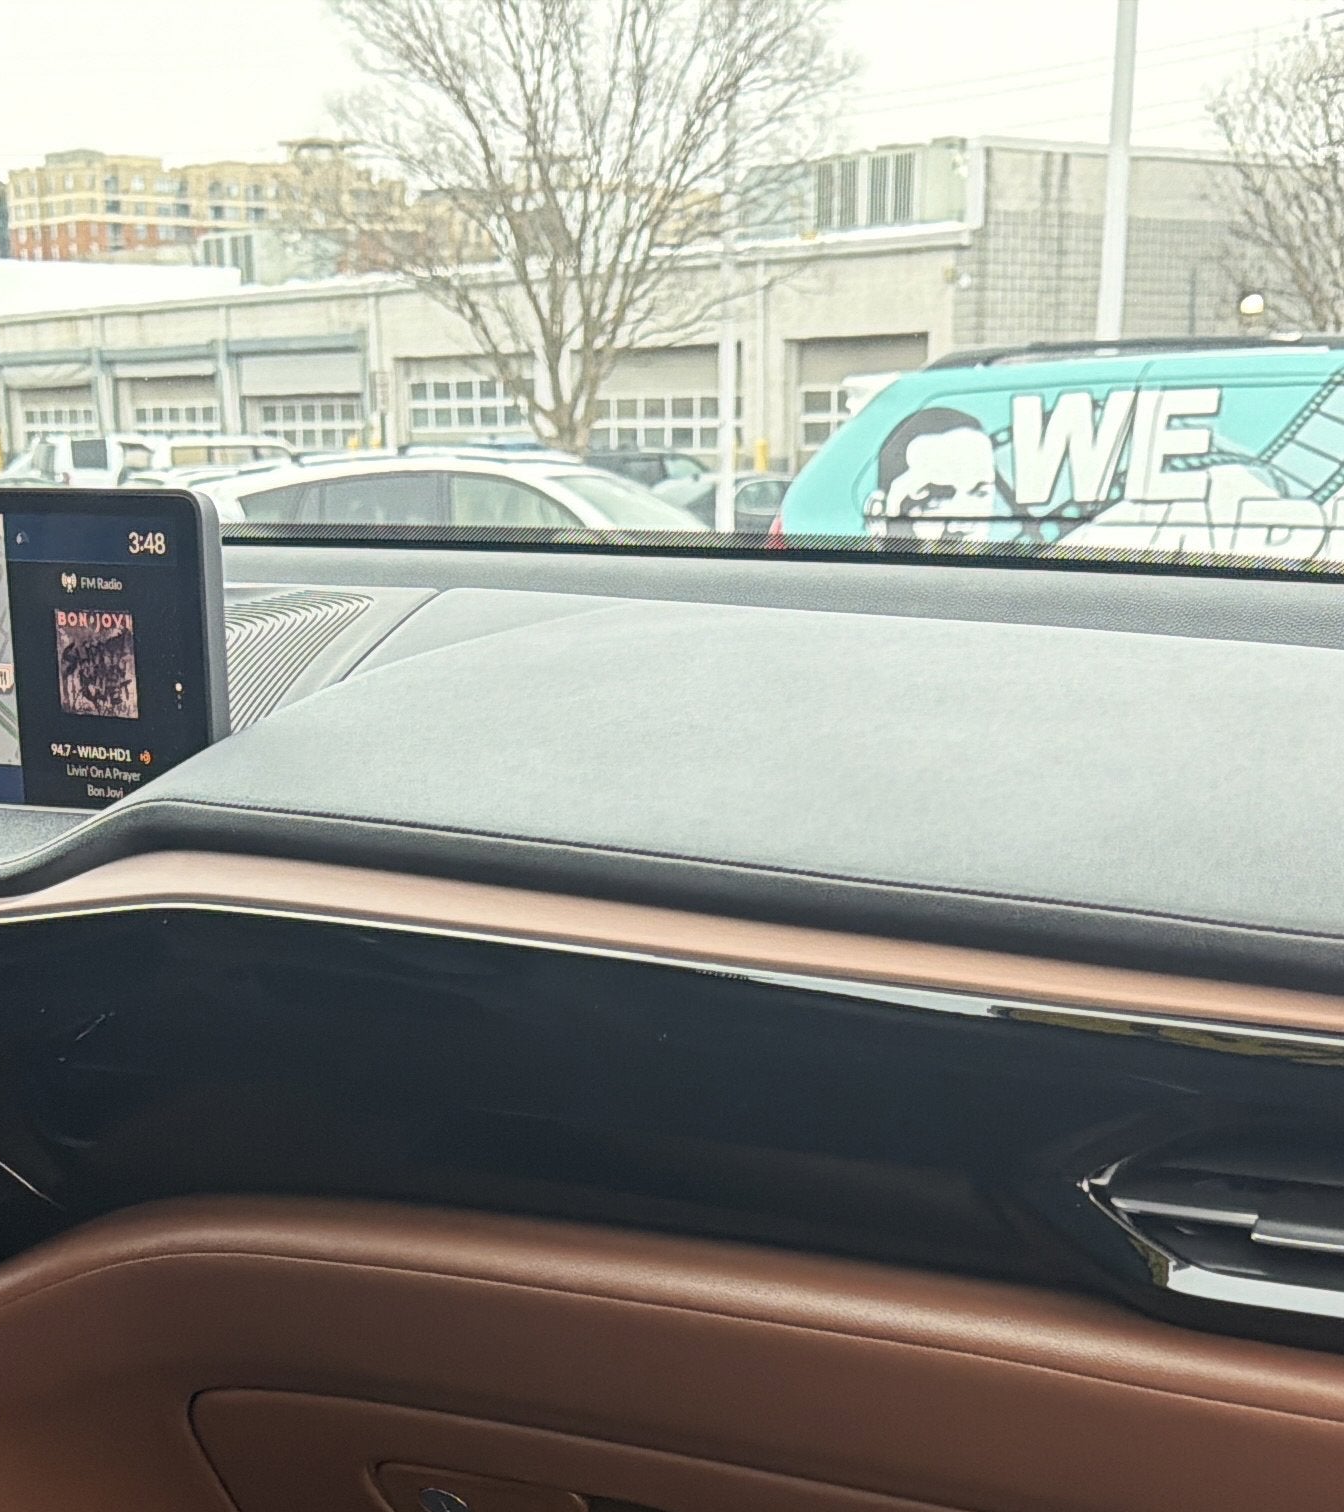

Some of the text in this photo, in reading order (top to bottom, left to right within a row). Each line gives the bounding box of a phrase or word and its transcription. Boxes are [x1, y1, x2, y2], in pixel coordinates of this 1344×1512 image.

[1011, 386, 1223, 504] WE
[128, 531, 166, 555] 3:48
[80, 577, 123, 591] FM Radio
[57, 611, 88, 627] BON
[51, 743, 71, 757] 94.7
[77, 745, 132, 762] WIAD-HD1
[67, 764, 141, 783] Livin' On A Prayer
[87, 784, 124, 799] Bon Jovi
